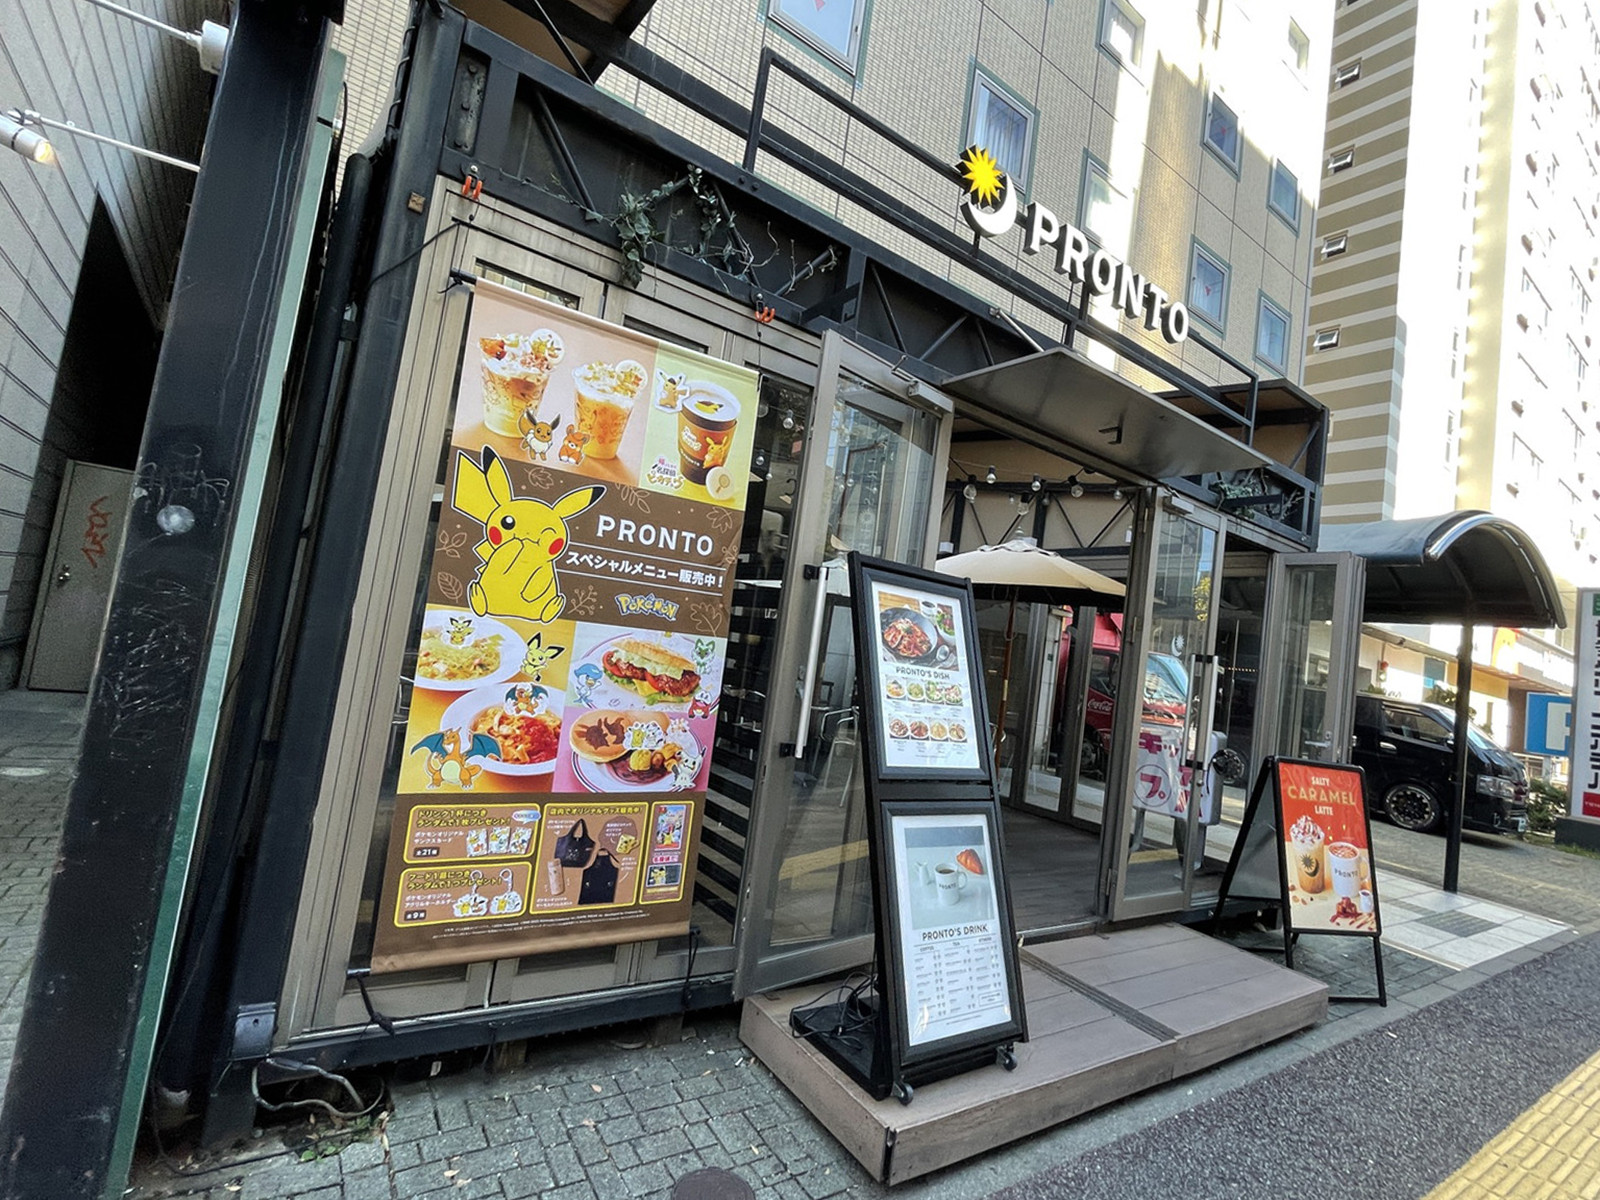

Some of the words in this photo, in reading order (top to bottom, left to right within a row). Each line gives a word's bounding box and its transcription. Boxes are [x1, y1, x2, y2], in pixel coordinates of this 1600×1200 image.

[1024, 202, 1189, 343] PRONTO
[596, 514, 714, 556] PRONTO
[895, 666, 932, 679] PRONTO'S
[933, 671, 950, 680] DISH
[1311, 776, 1330, 787] SALTY
[1287, 785, 1356, 805] CARAMEL
[1314, 805, 1334, 816] LATTE
[1333, 867, 1359, 878] PRONTO
[922, 927, 962, 942] PRONTO'S
[963, 924, 988, 936] DRINK
